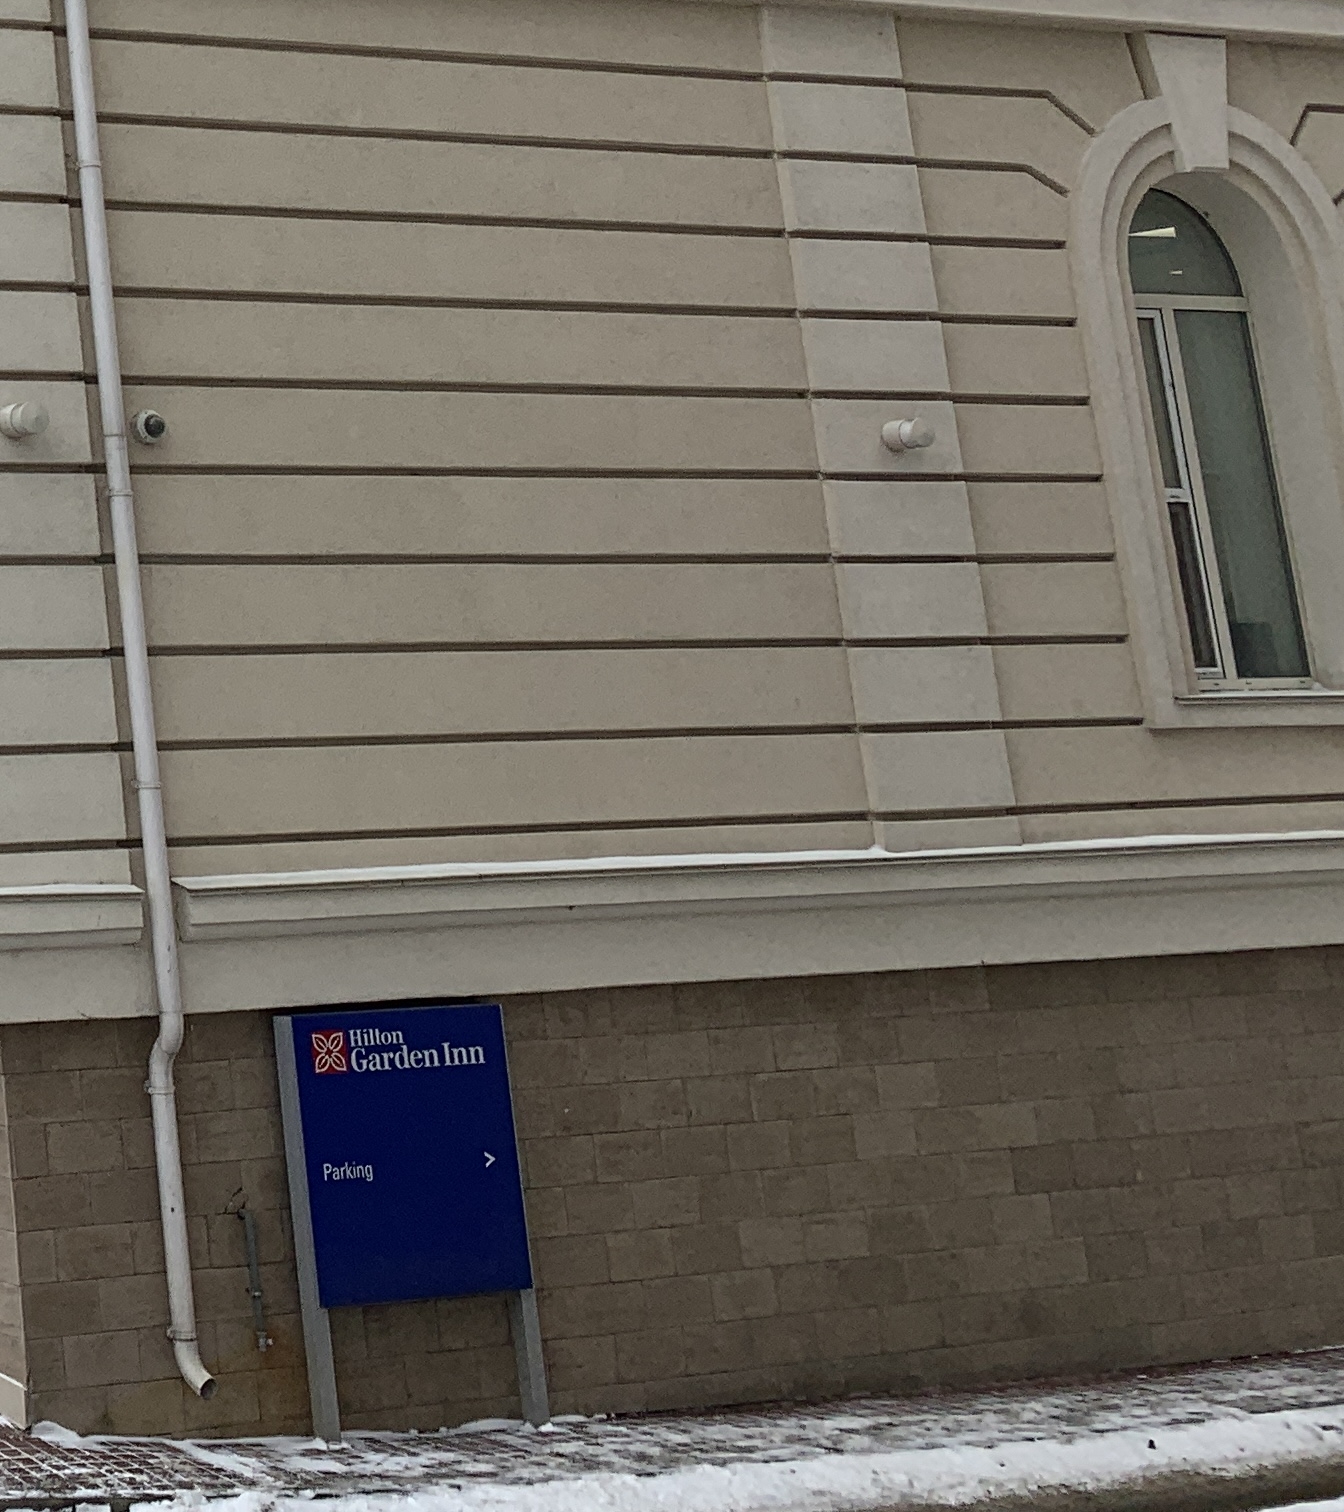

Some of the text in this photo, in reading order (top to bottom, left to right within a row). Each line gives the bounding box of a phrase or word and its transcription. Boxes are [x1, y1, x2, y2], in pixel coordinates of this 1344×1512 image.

[348, 1028, 404, 1047] Hilton
[350, 1042, 486, 1073] Garden Inn
[323, 1161, 374, 1182] Parking
